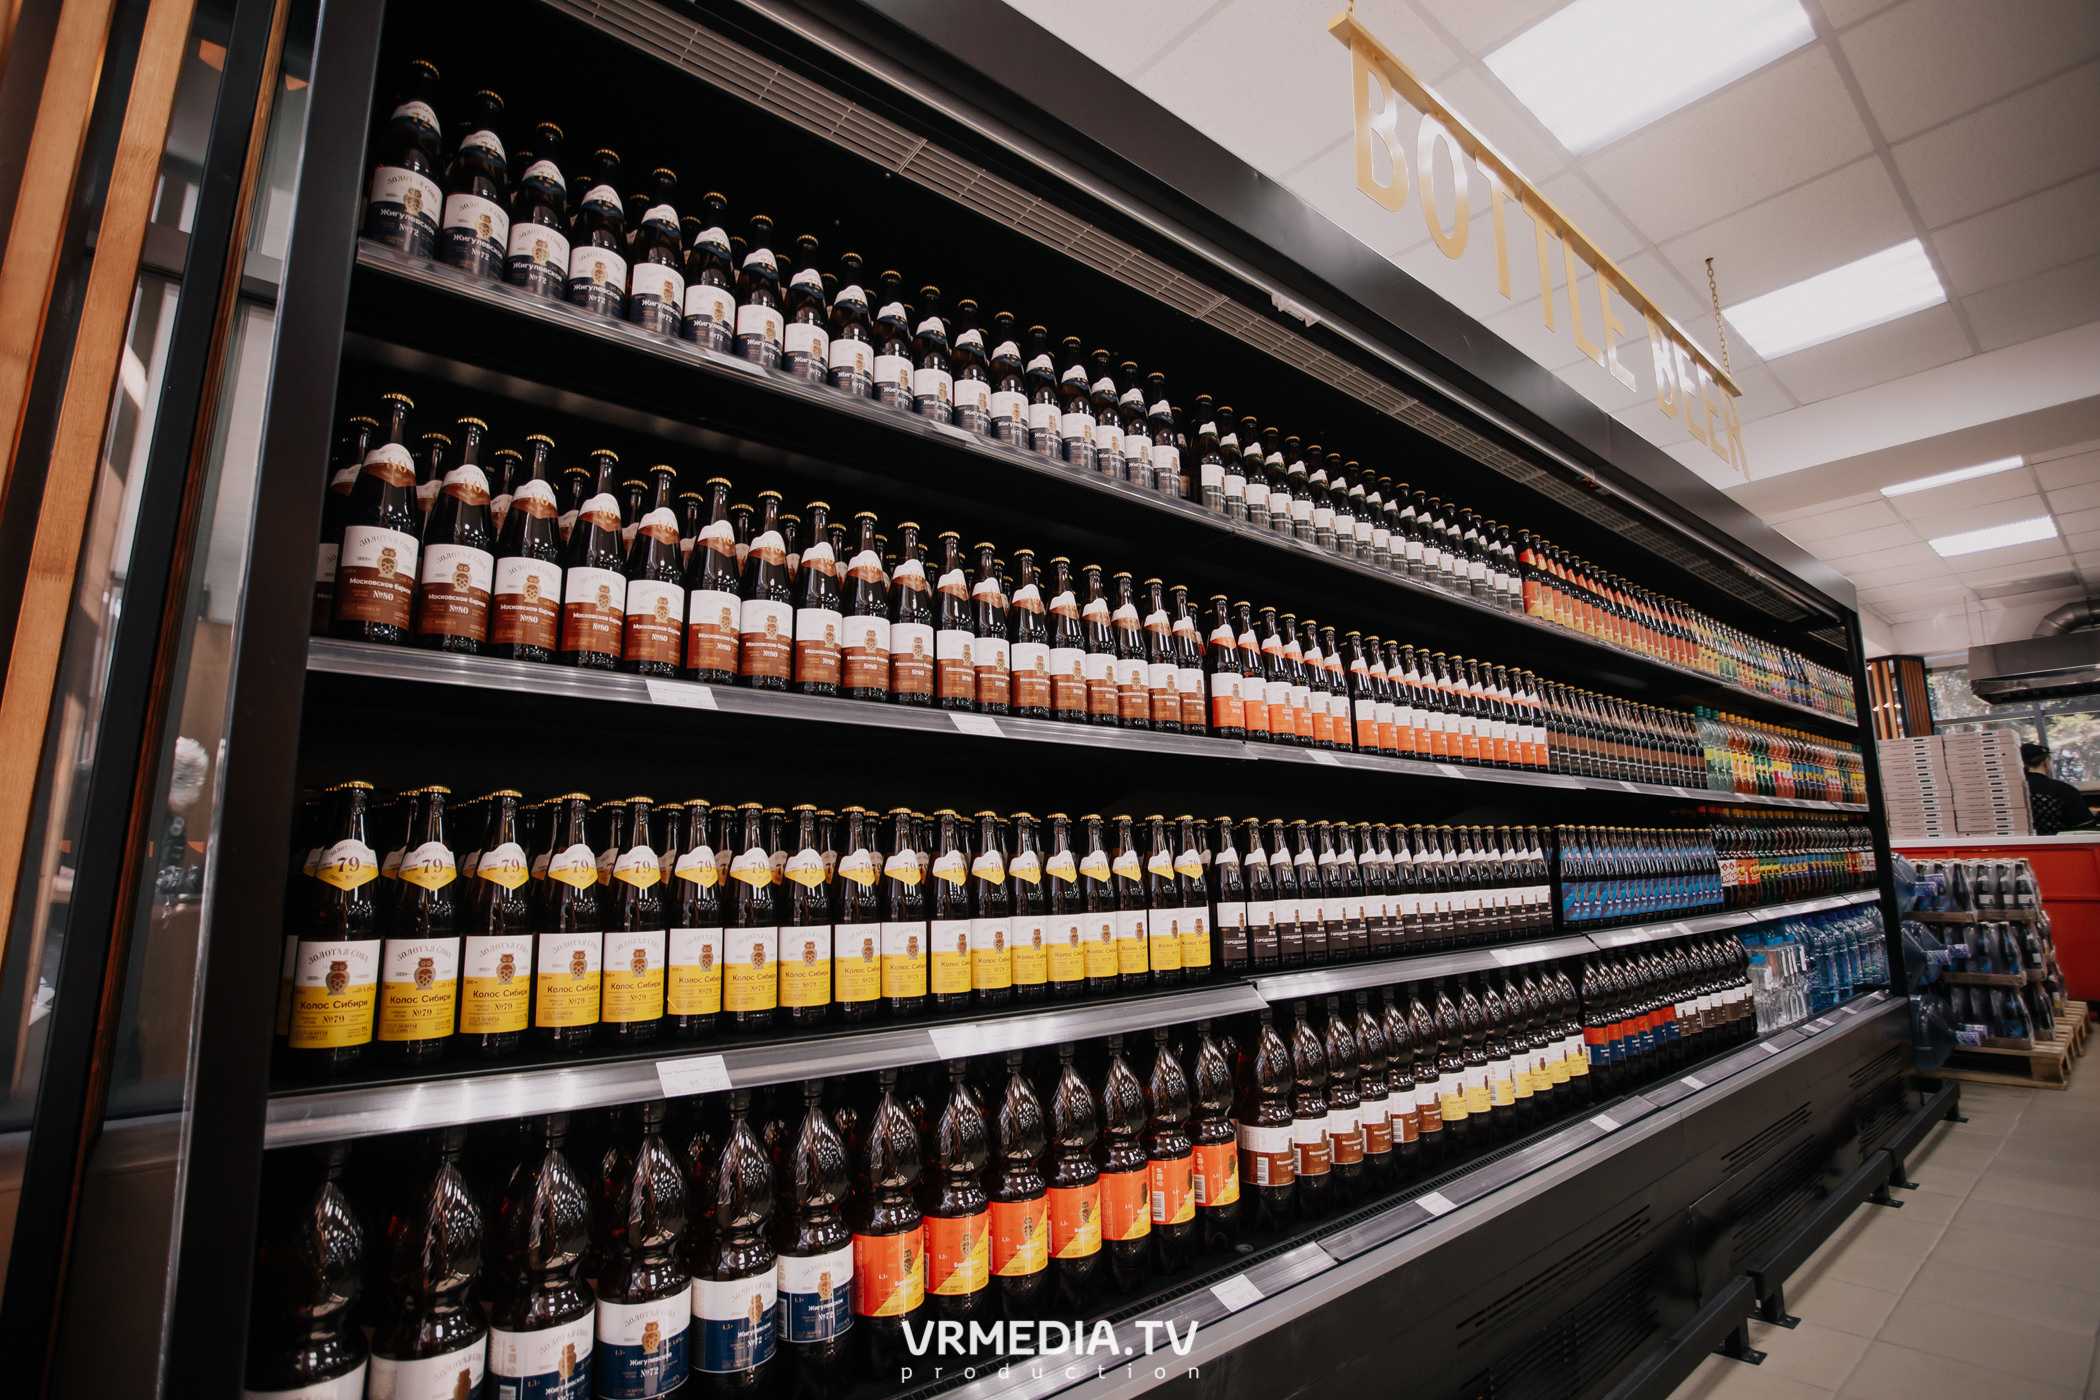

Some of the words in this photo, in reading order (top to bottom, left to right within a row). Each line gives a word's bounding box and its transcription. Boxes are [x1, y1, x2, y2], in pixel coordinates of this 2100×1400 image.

[399, 223, 419, 237] №72
[471, 247, 490, 261] №72
[1351, 38, 1637, 394] BOTTLE
[1644, 304, 1752, 482] BEER
[528, 272, 547, 284] №72
[372, 589, 395, 601] №80
[449, 604, 469, 614] №80
[519, 614, 538, 623] №80
[592, 622, 610, 632] №80
[336, 856, 361, 873] 79
[421, 858, 444, 874] 79
[501, 858, 521, 873] 79
[571, 859, 590, 874] 79
[633, 860, 652, 874] 79
[696, 860, 713, 873] 79
[750, 861, 766, 874] 79
[802, 862, 819, 874] 79
[858, 862, 872, 873] 79
[903, 862, 917, 873] 79
[308, 948, 350, 966] ЗОЛОТАЯ
[396, 945, 435, 962] ЗОЛОТАЯ
[678, 976, 702, 984] Колос
[732, 974, 755, 982] Колос
[547, 985, 574, 994] Колос
[610, 982, 635, 990] Колос
[390, 995, 418, 1004] Колос
[421, 993, 452, 1003] Сибири
[473, 990, 500, 998] Колос
[629, 993, 647, 1001] №79
[300, 1001, 330, 1010] Колос
[333, 999, 368, 1009] Сибири
[494, 1002, 513, 1011] №79
[568, 997, 586, 1006] №79
[411, 1008, 433, 1018] №79
[322, 1015, 345, 1024] №79
[640, 1366, 659, 1378] №72
